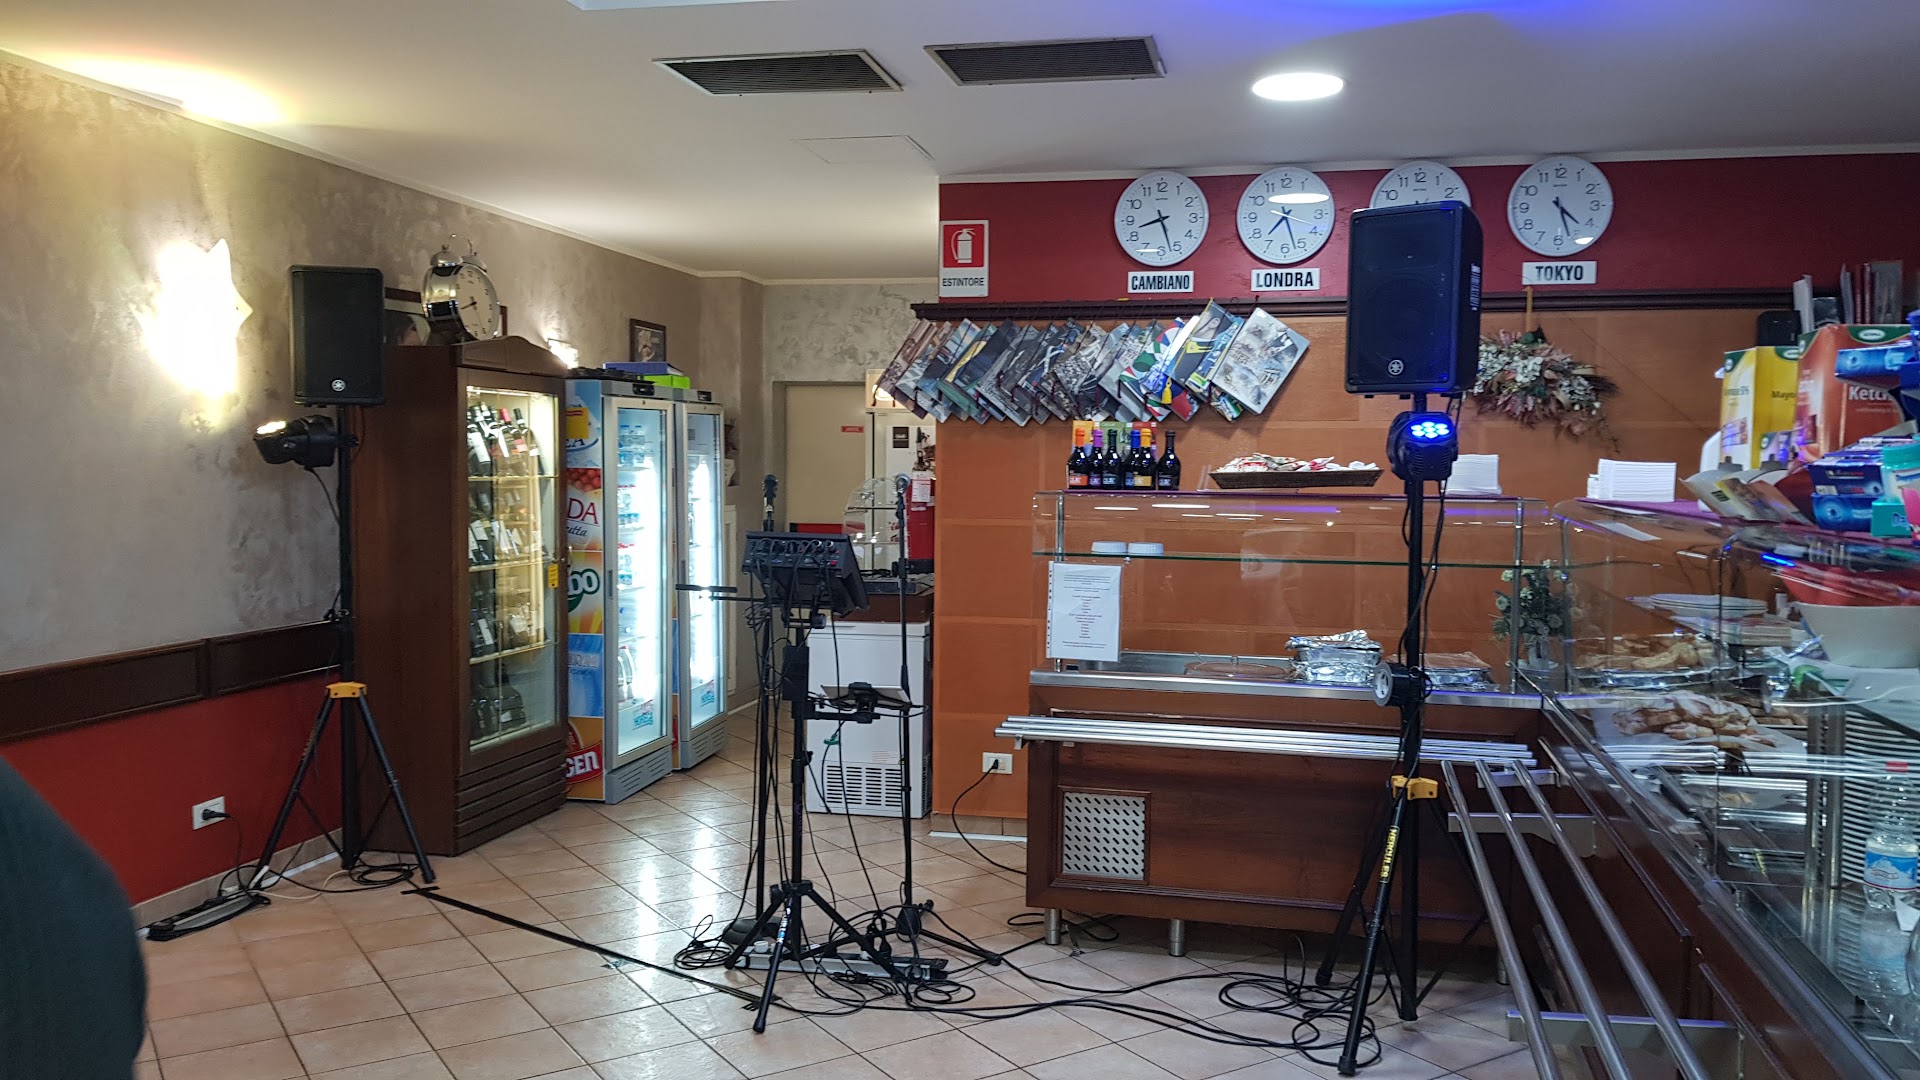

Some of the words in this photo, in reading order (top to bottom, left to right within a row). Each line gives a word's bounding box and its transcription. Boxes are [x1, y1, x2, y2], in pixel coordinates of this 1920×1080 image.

[1415, 172, 1426, 182] 12
[1539, 173, 1548, 182] 11
[1554, 167, 1567, 178] 12
[1577, 172, 1581, 181] 1
[1281, 177, 1292, 188] 12
[1301, 181, 1305, 190] 1
[1400, 177, 1408, 187] 11
[1436, 176, 1440, 185] 1
[1142, 187, 1151, 196] 11
[1157, 182, 1168, 192] 12
[1176, 186, 1180, 195] 1
[1266, 183, 1275, 192] 11
[1586, 184, 1596, 194] 2
[1445, 188, 1454, 198] 2
[1129, 199, 1142, 209] 10
[1185, 197, 1194, 207] 2
[1591, 200, 1600, 211] 3
[1519, 203, 1529, 213] 9
[1189, 213, 1198, 223] 3
[1248, 212, 1257, 222] 9
[1314, 209, 1323, 219] 3
[1126, 216, 1134, 225] 9
[1524, 219, 1533, 230] 8
[1585, 218, 1594, 227] 4
[1185, 230, 1193, 239] 4
[1252, 229, 1261, 239] 8
[1309, 226, 1318, 235] 4
[1130, 232, 1139, 241] 8
[1537, 231, 1545, 241] 7
[1554, 235, 1563, 245] 6
[1173, 241, 1182, 251] 5
[1264, 240, 1273, 249] 7
[1298, 238, 1306, 248] 5
[1156, 246, 1166, 256] 6
[1281, 244, 1290, 254] 6
[1536, 265, 1583, 281] TOKYO
[942, 278, 984, 286] ESTINTORE
[1132, 275, 1190, 290] CAMBIANO
[1256, 272, 1313, 287] LONDRA
[1380, 828, 1398, 878] HERCULES
